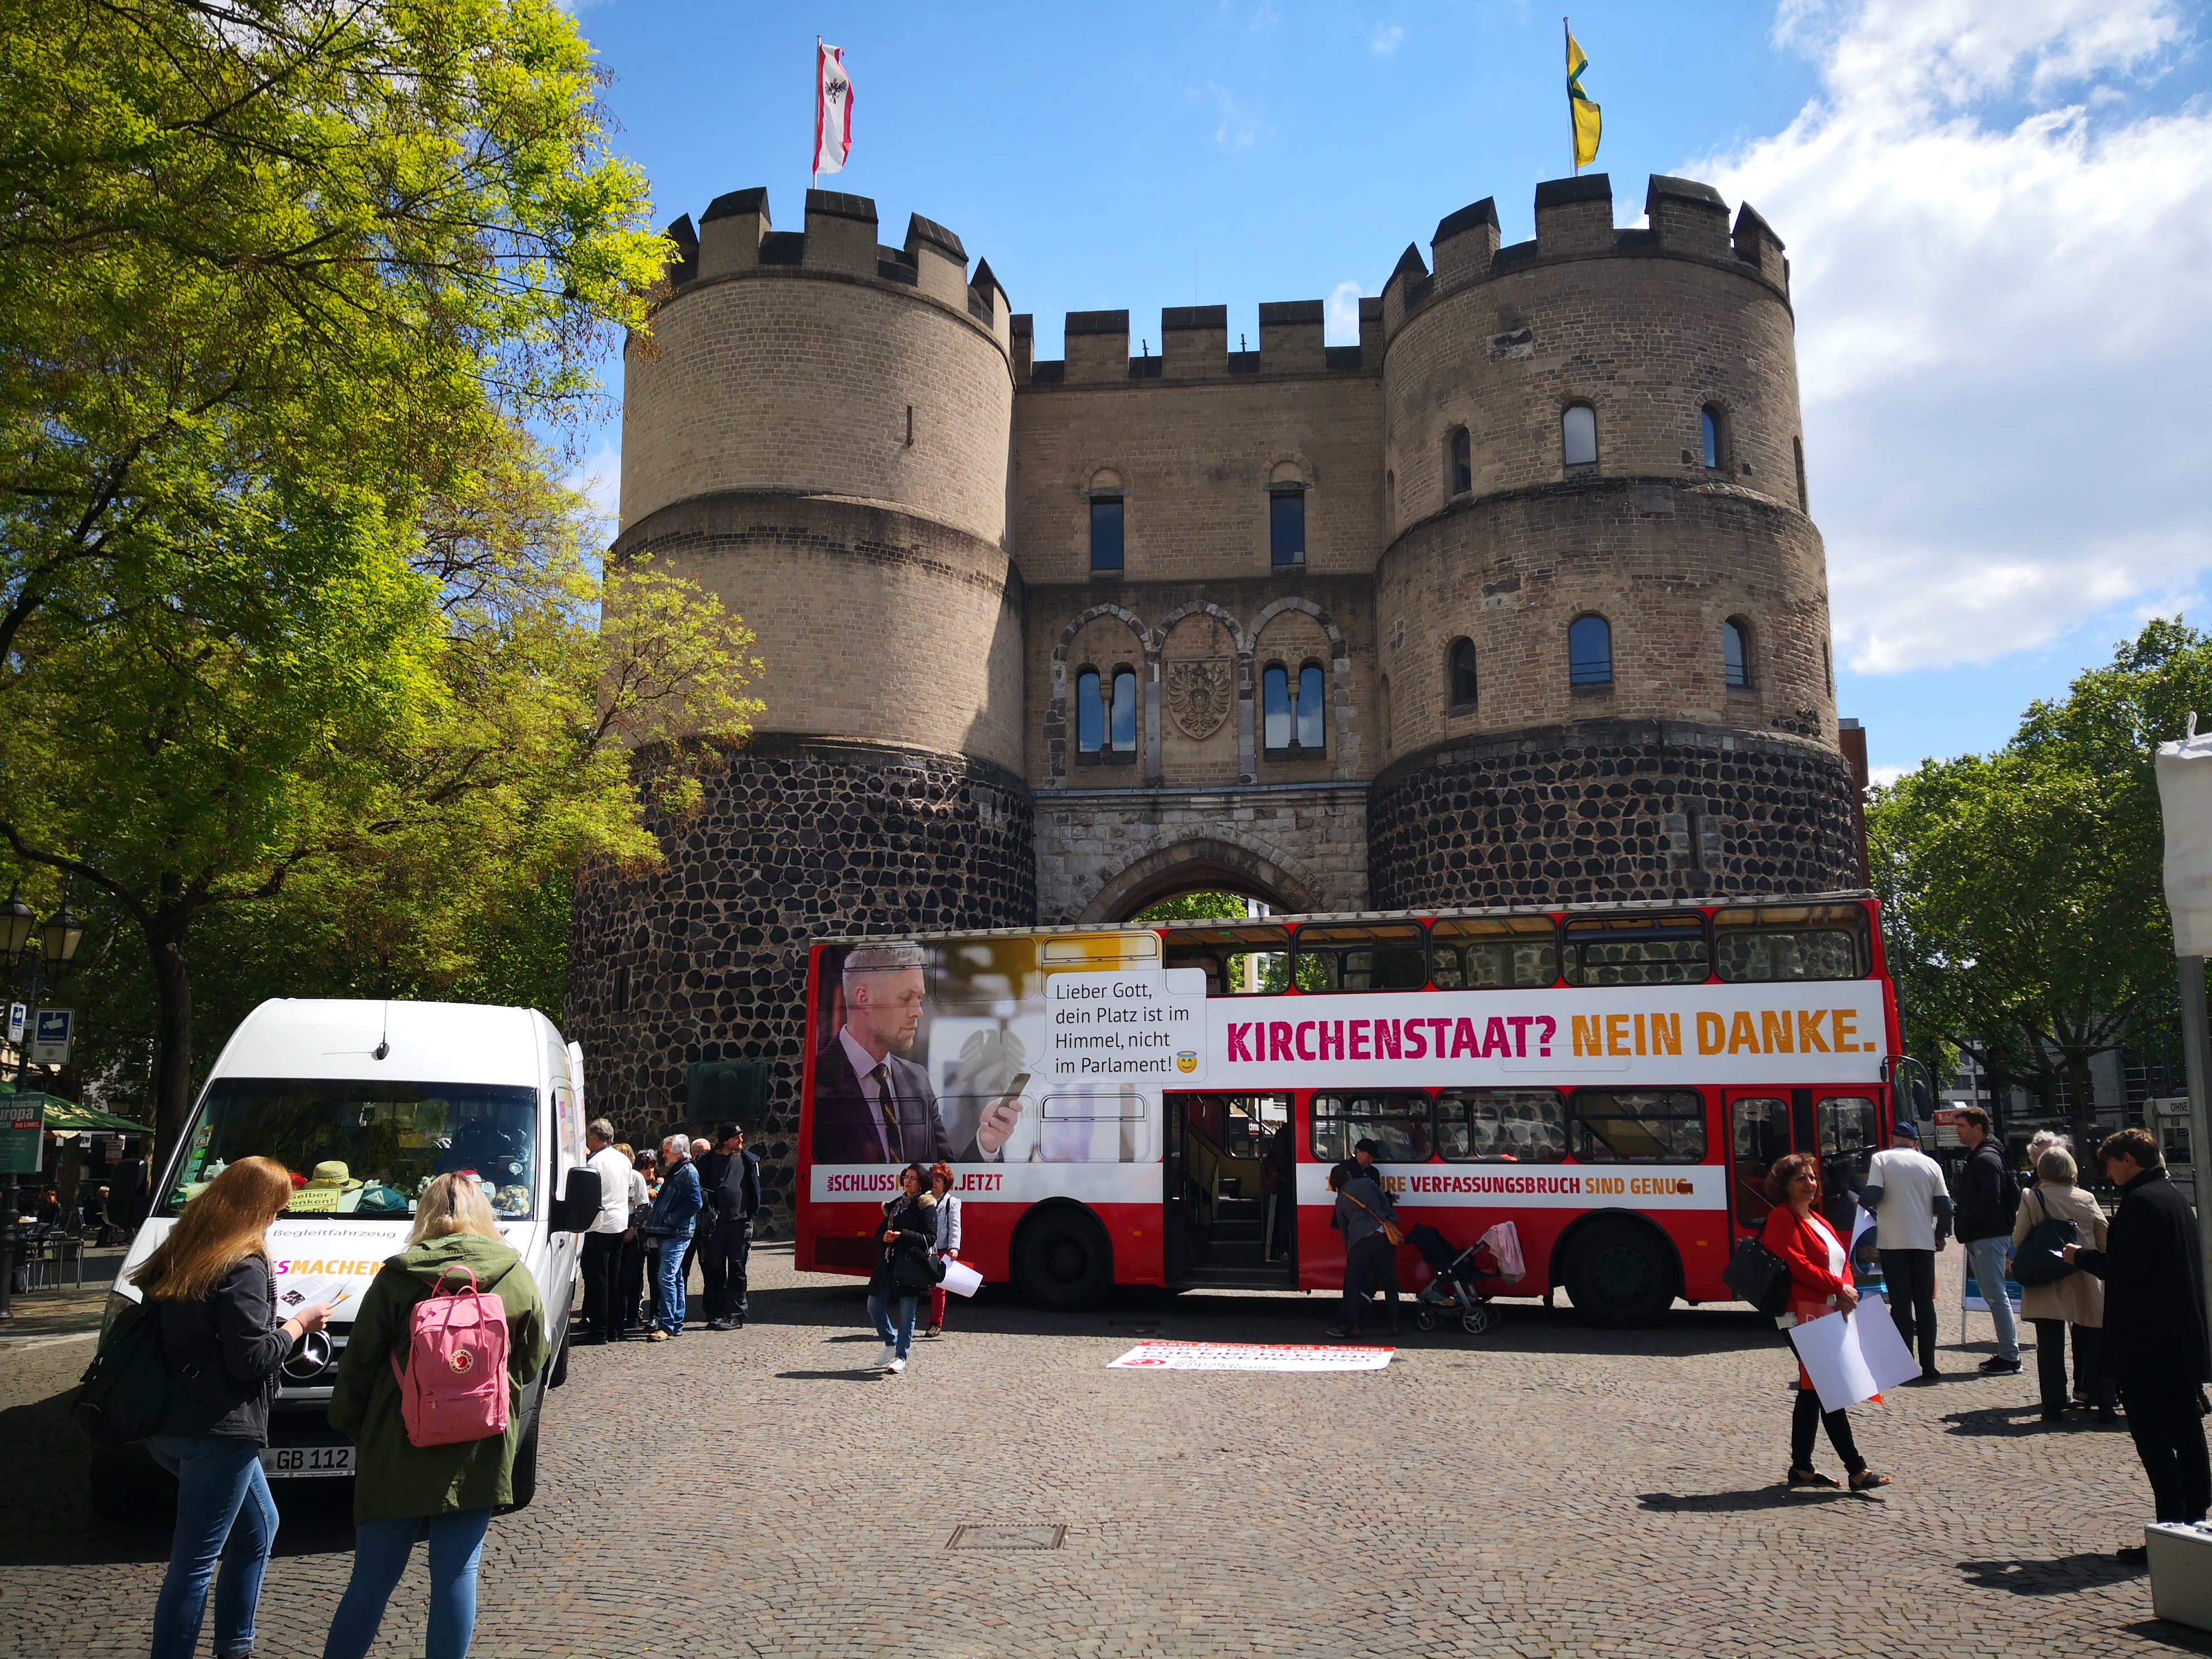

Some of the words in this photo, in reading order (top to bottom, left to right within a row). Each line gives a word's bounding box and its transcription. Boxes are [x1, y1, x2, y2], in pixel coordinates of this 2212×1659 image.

[1056, 984, 1107, 1000] Lieber
[1113, 982, 1152, 999] Gott,
[1056, 1008, 1090, 1024] dein
[1097, 1007, 1137, 1023] Platz
[1143, 1006, 1163, 1022] ist
[1169, 1006, 1189, 1021] im
[1056, 1032, 1124, 1050] Himmel,
[1129, 1031, 1170, 1047] nicht
[1228, 1015, 1556, 1062] KIRCHENSTAAT?
[1571, 1013, 1682, 1057] NEIN
[1696, 1010, 1876, 1055] DANKE.
[1056, 1059, 1074, 1073] im
[1081, 1056, 1171, 1073] Parlament!
[2170, 1102, 2188, 1112] OHNE
[1410, 1176, 1580, 1194] VERFASSUNGSBRUCH
[1585, 1177, 1625, 1194] SIND
[273, 1229, 396, 1239] Begleitfahrzeug
[278, 1451, 304, 1469] GB
[309, 1449, 349, 1469] 112
